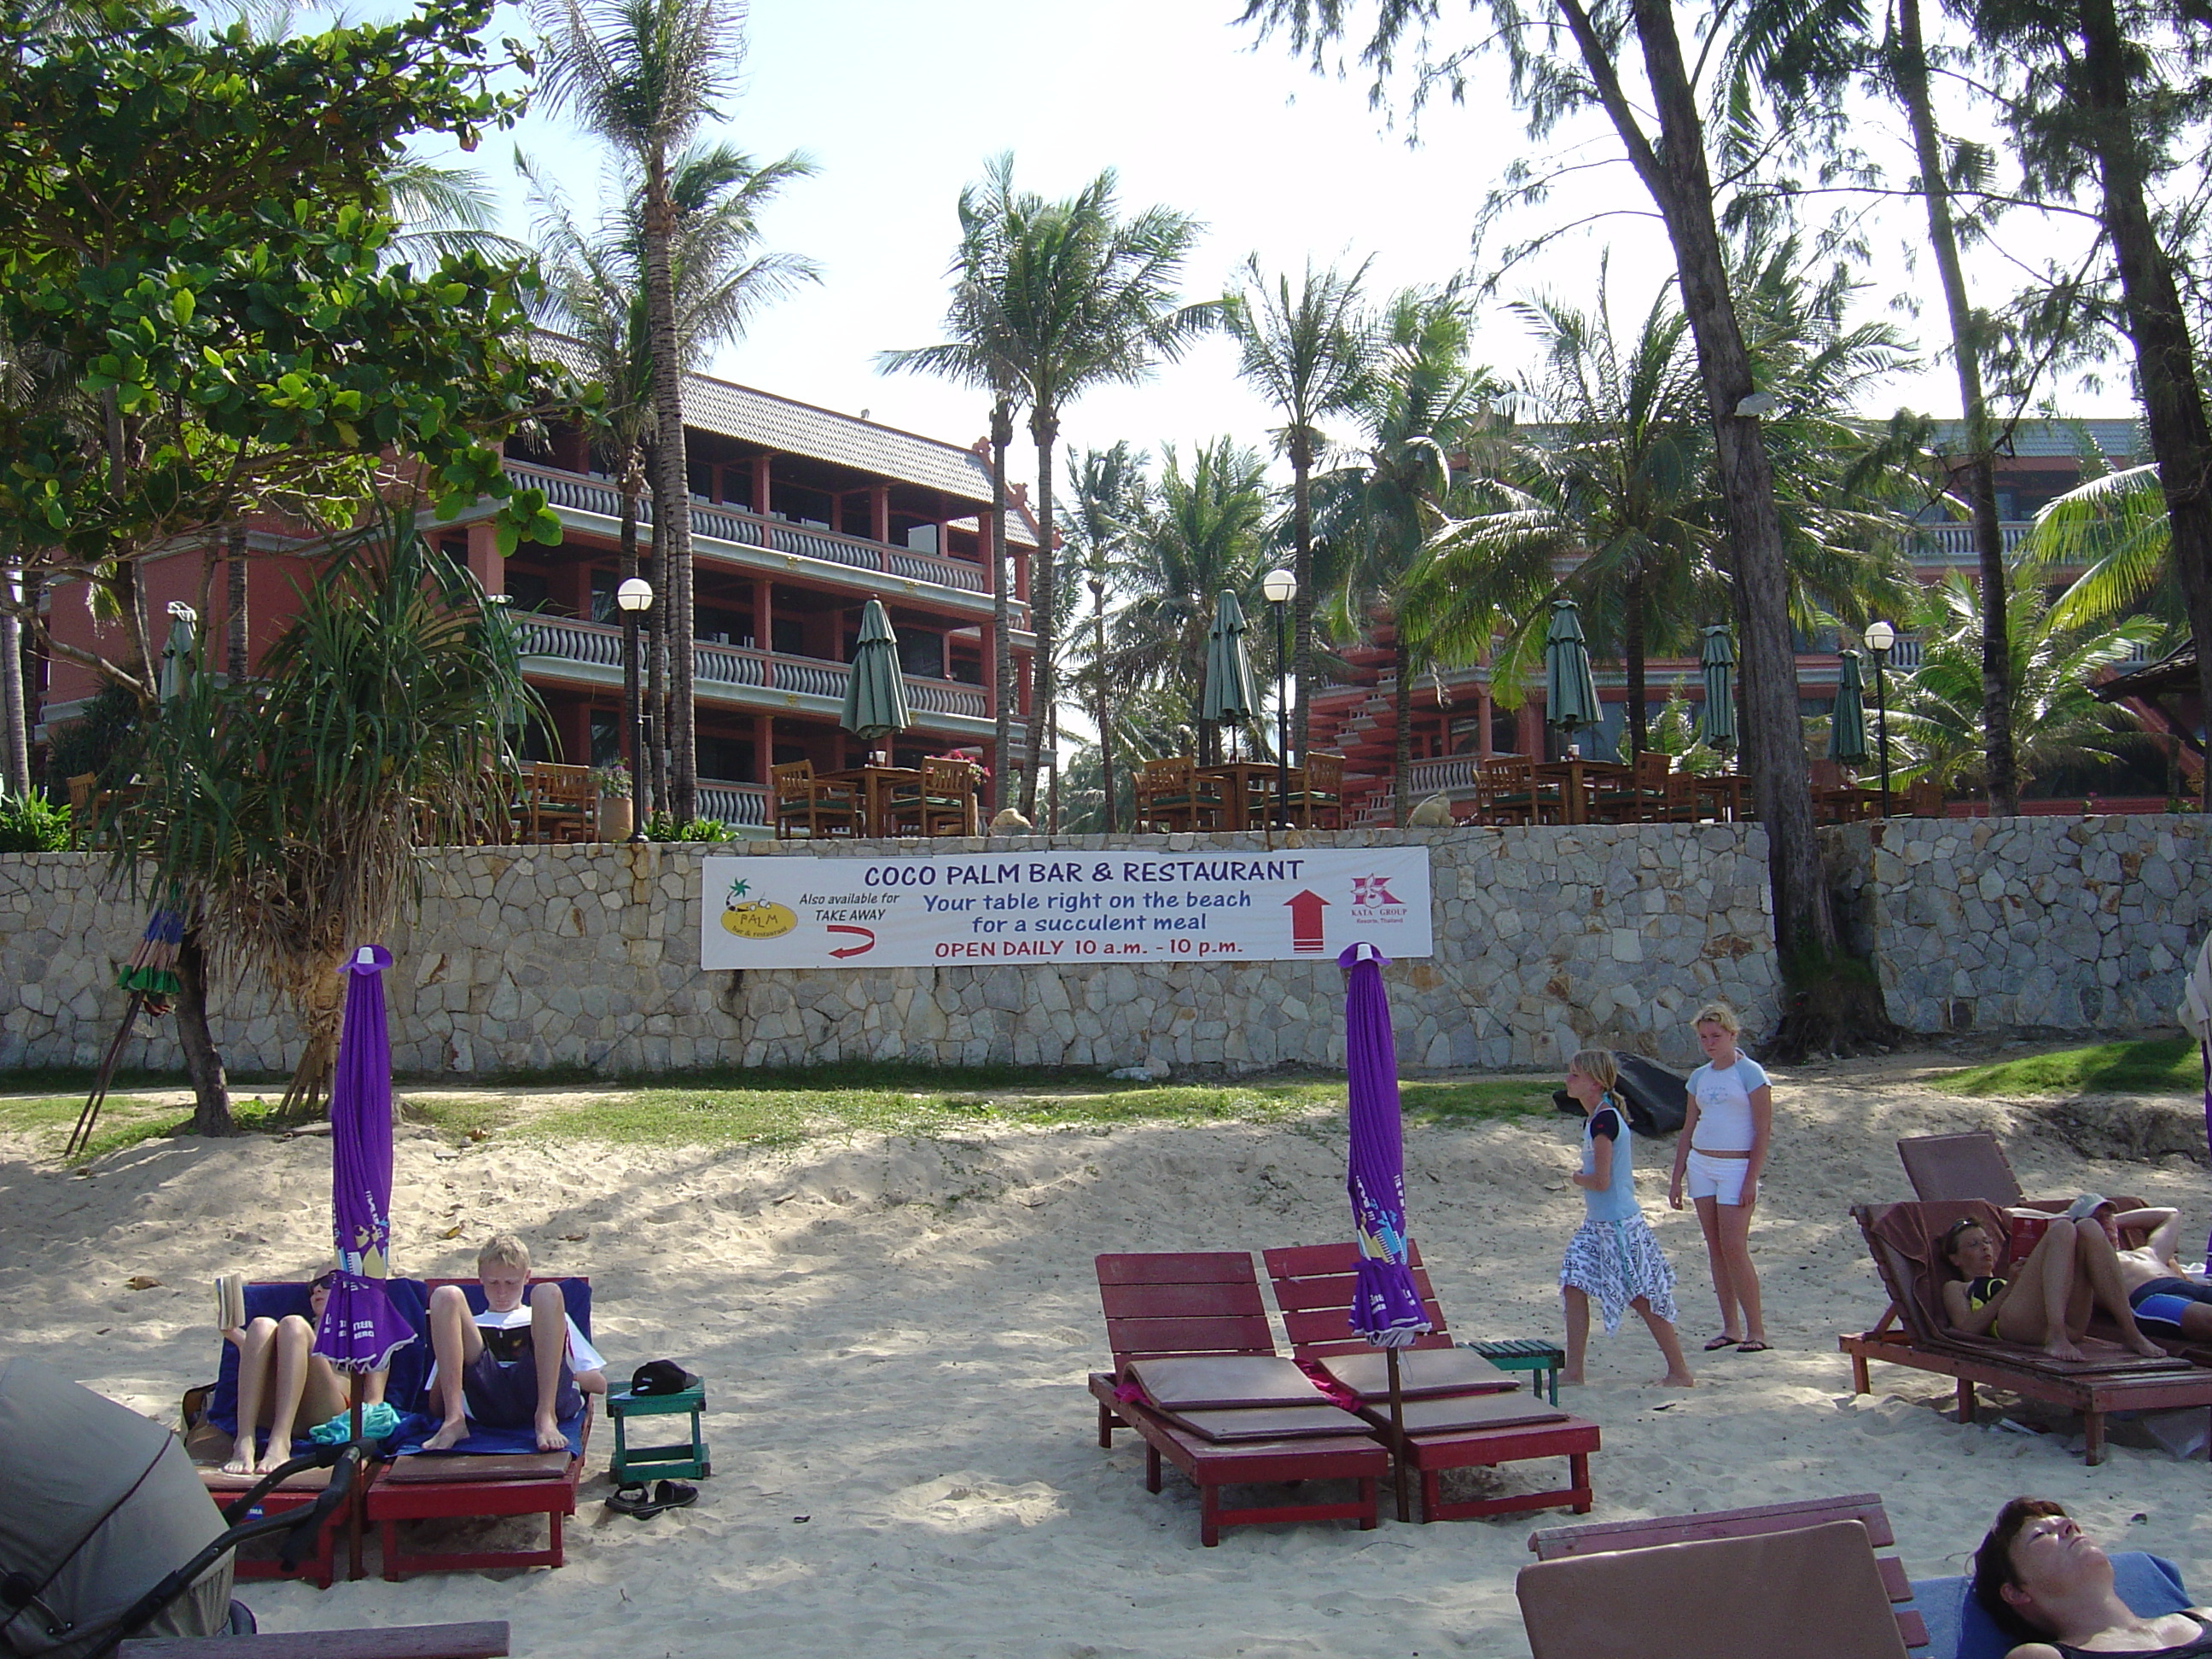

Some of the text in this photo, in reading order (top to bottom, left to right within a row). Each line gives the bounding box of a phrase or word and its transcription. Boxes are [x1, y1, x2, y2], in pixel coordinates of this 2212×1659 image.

[864, 860, 1304, 886] COCO PALM BAR & RESTAURANT
[799, 893, 899, 905] Also available for
[923, 890, 1251, 913] Your table right on the beach
[740, 913, 777, 928] PALM
[815, 909, 887, 922] TAKE AWAY
[972, 913, 1206, 934] for a succulent meal
[934, 941, 996, 958] OPEN
[1004, 940, 1064, 957] DAILY
[1075, 940, 1096, 955] 10
[1103, 942, 1148, 955] a.m.
[1170, 939, 1191, 954] 10
[1198, 941, 1243, 958] p.m.
